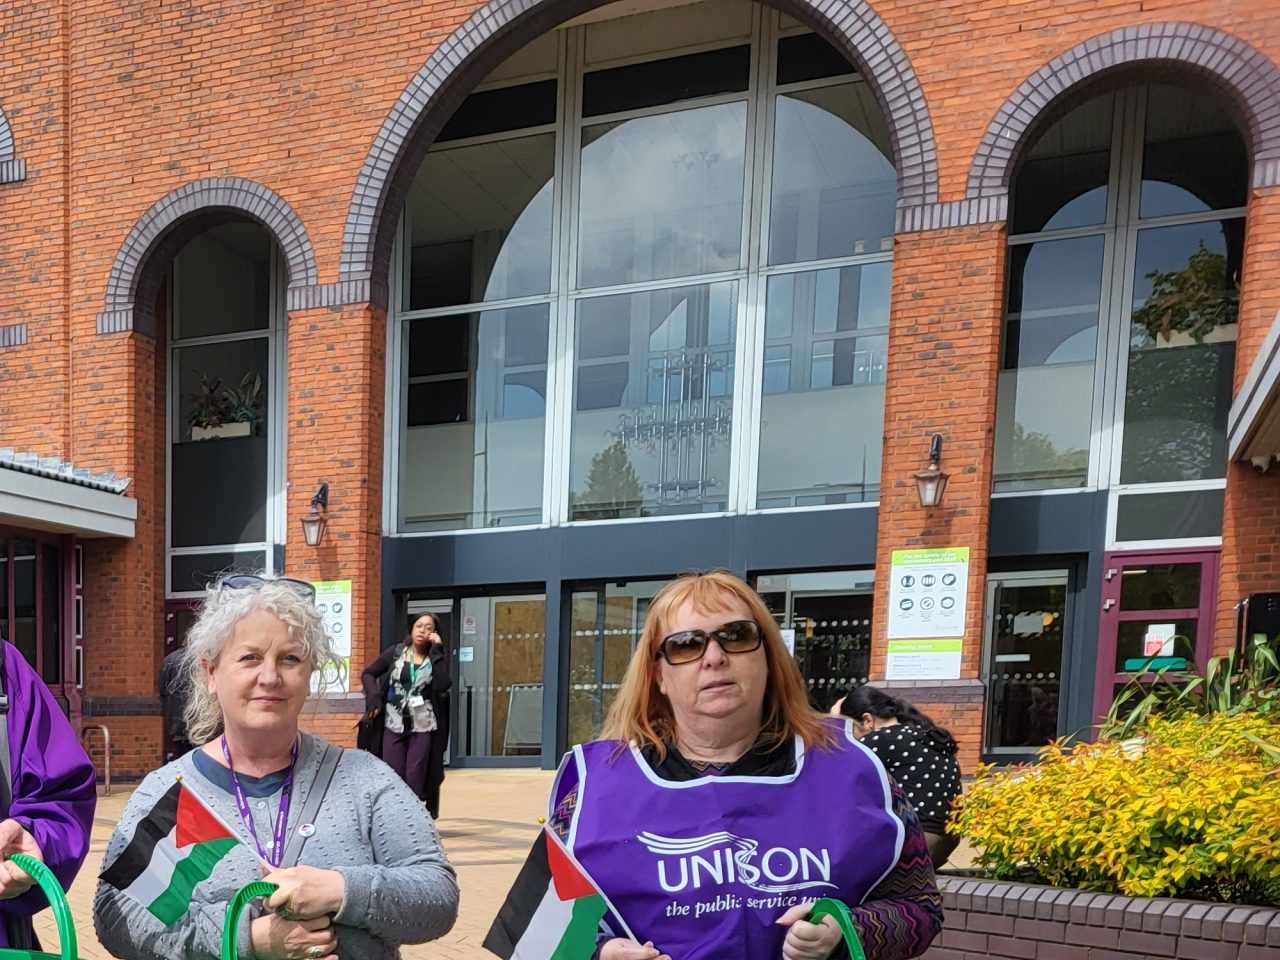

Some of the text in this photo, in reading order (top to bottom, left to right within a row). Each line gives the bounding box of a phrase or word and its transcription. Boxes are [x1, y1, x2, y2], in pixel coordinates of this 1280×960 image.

[657, 846, 832, 892] UNISON
[665, 901, 690, 917] the
[746, 892, 797, 909] service
